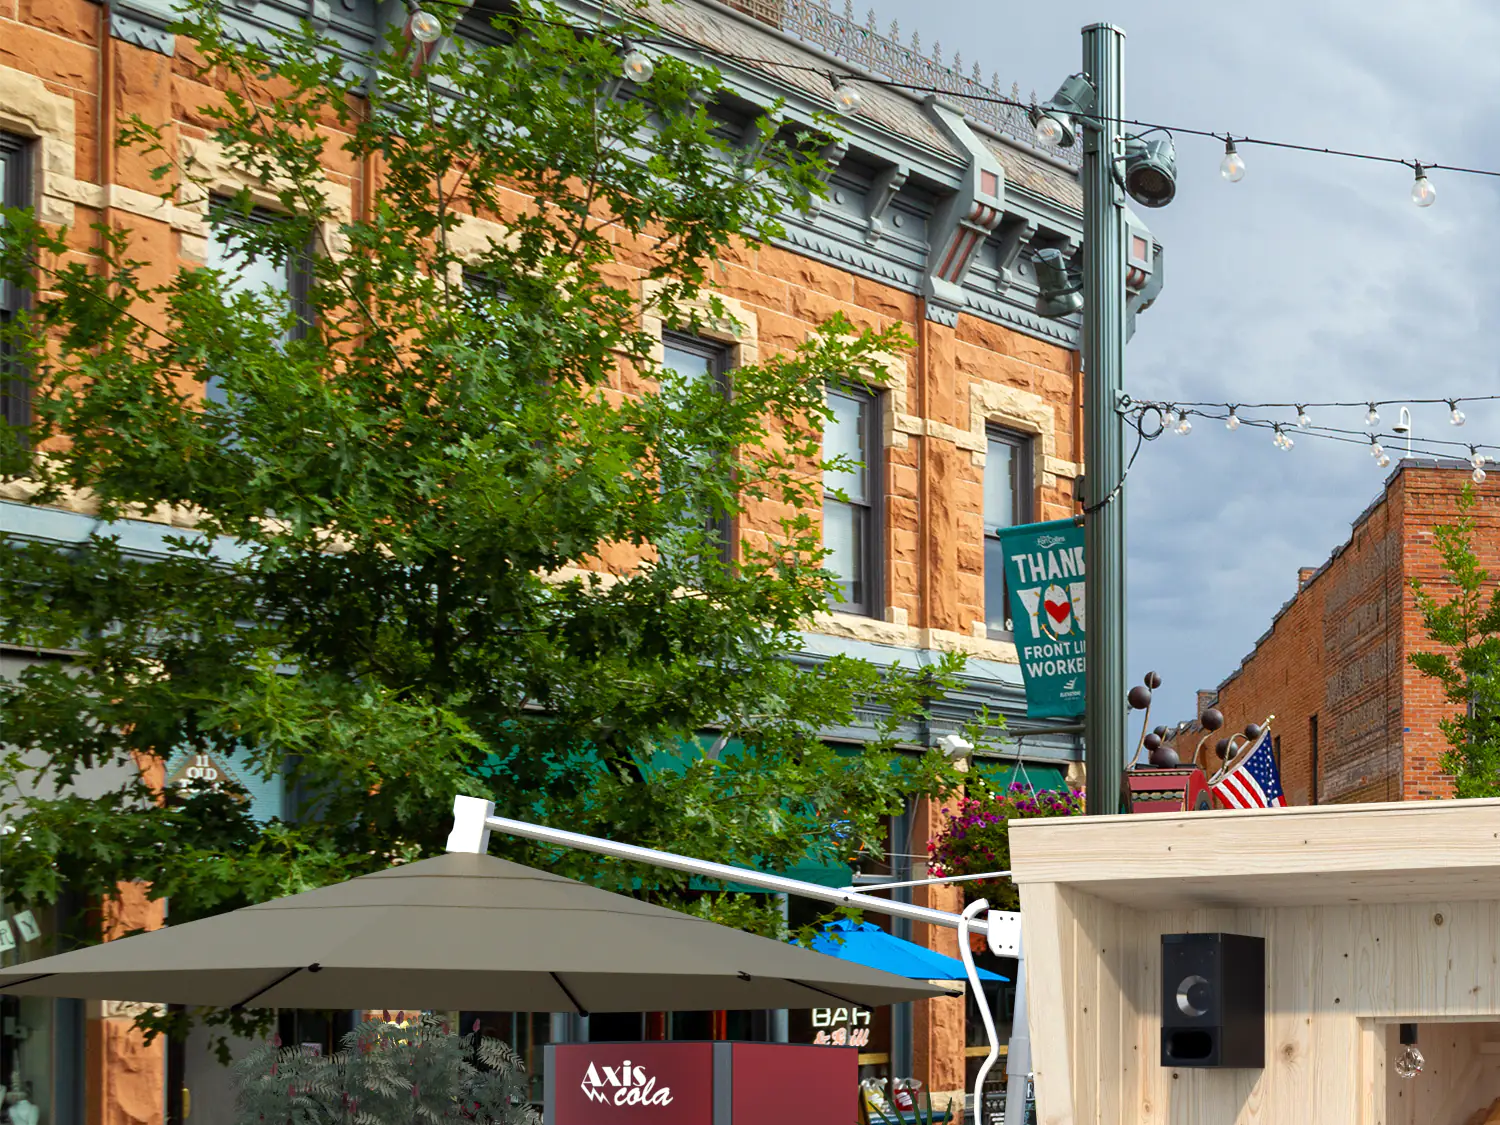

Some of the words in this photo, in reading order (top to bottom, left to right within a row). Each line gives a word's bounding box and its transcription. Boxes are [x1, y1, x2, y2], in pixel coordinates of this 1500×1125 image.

[1024, 642, 1070, 660] FRONT
[1074, 640, 1086, 654] LI
[1026, 657, 1086, 678] WORKE
[186, 766, 218, 781] OLD
[581, 1060, 647, 1087] Axis
[614, 1076, 674, 1106] cola
